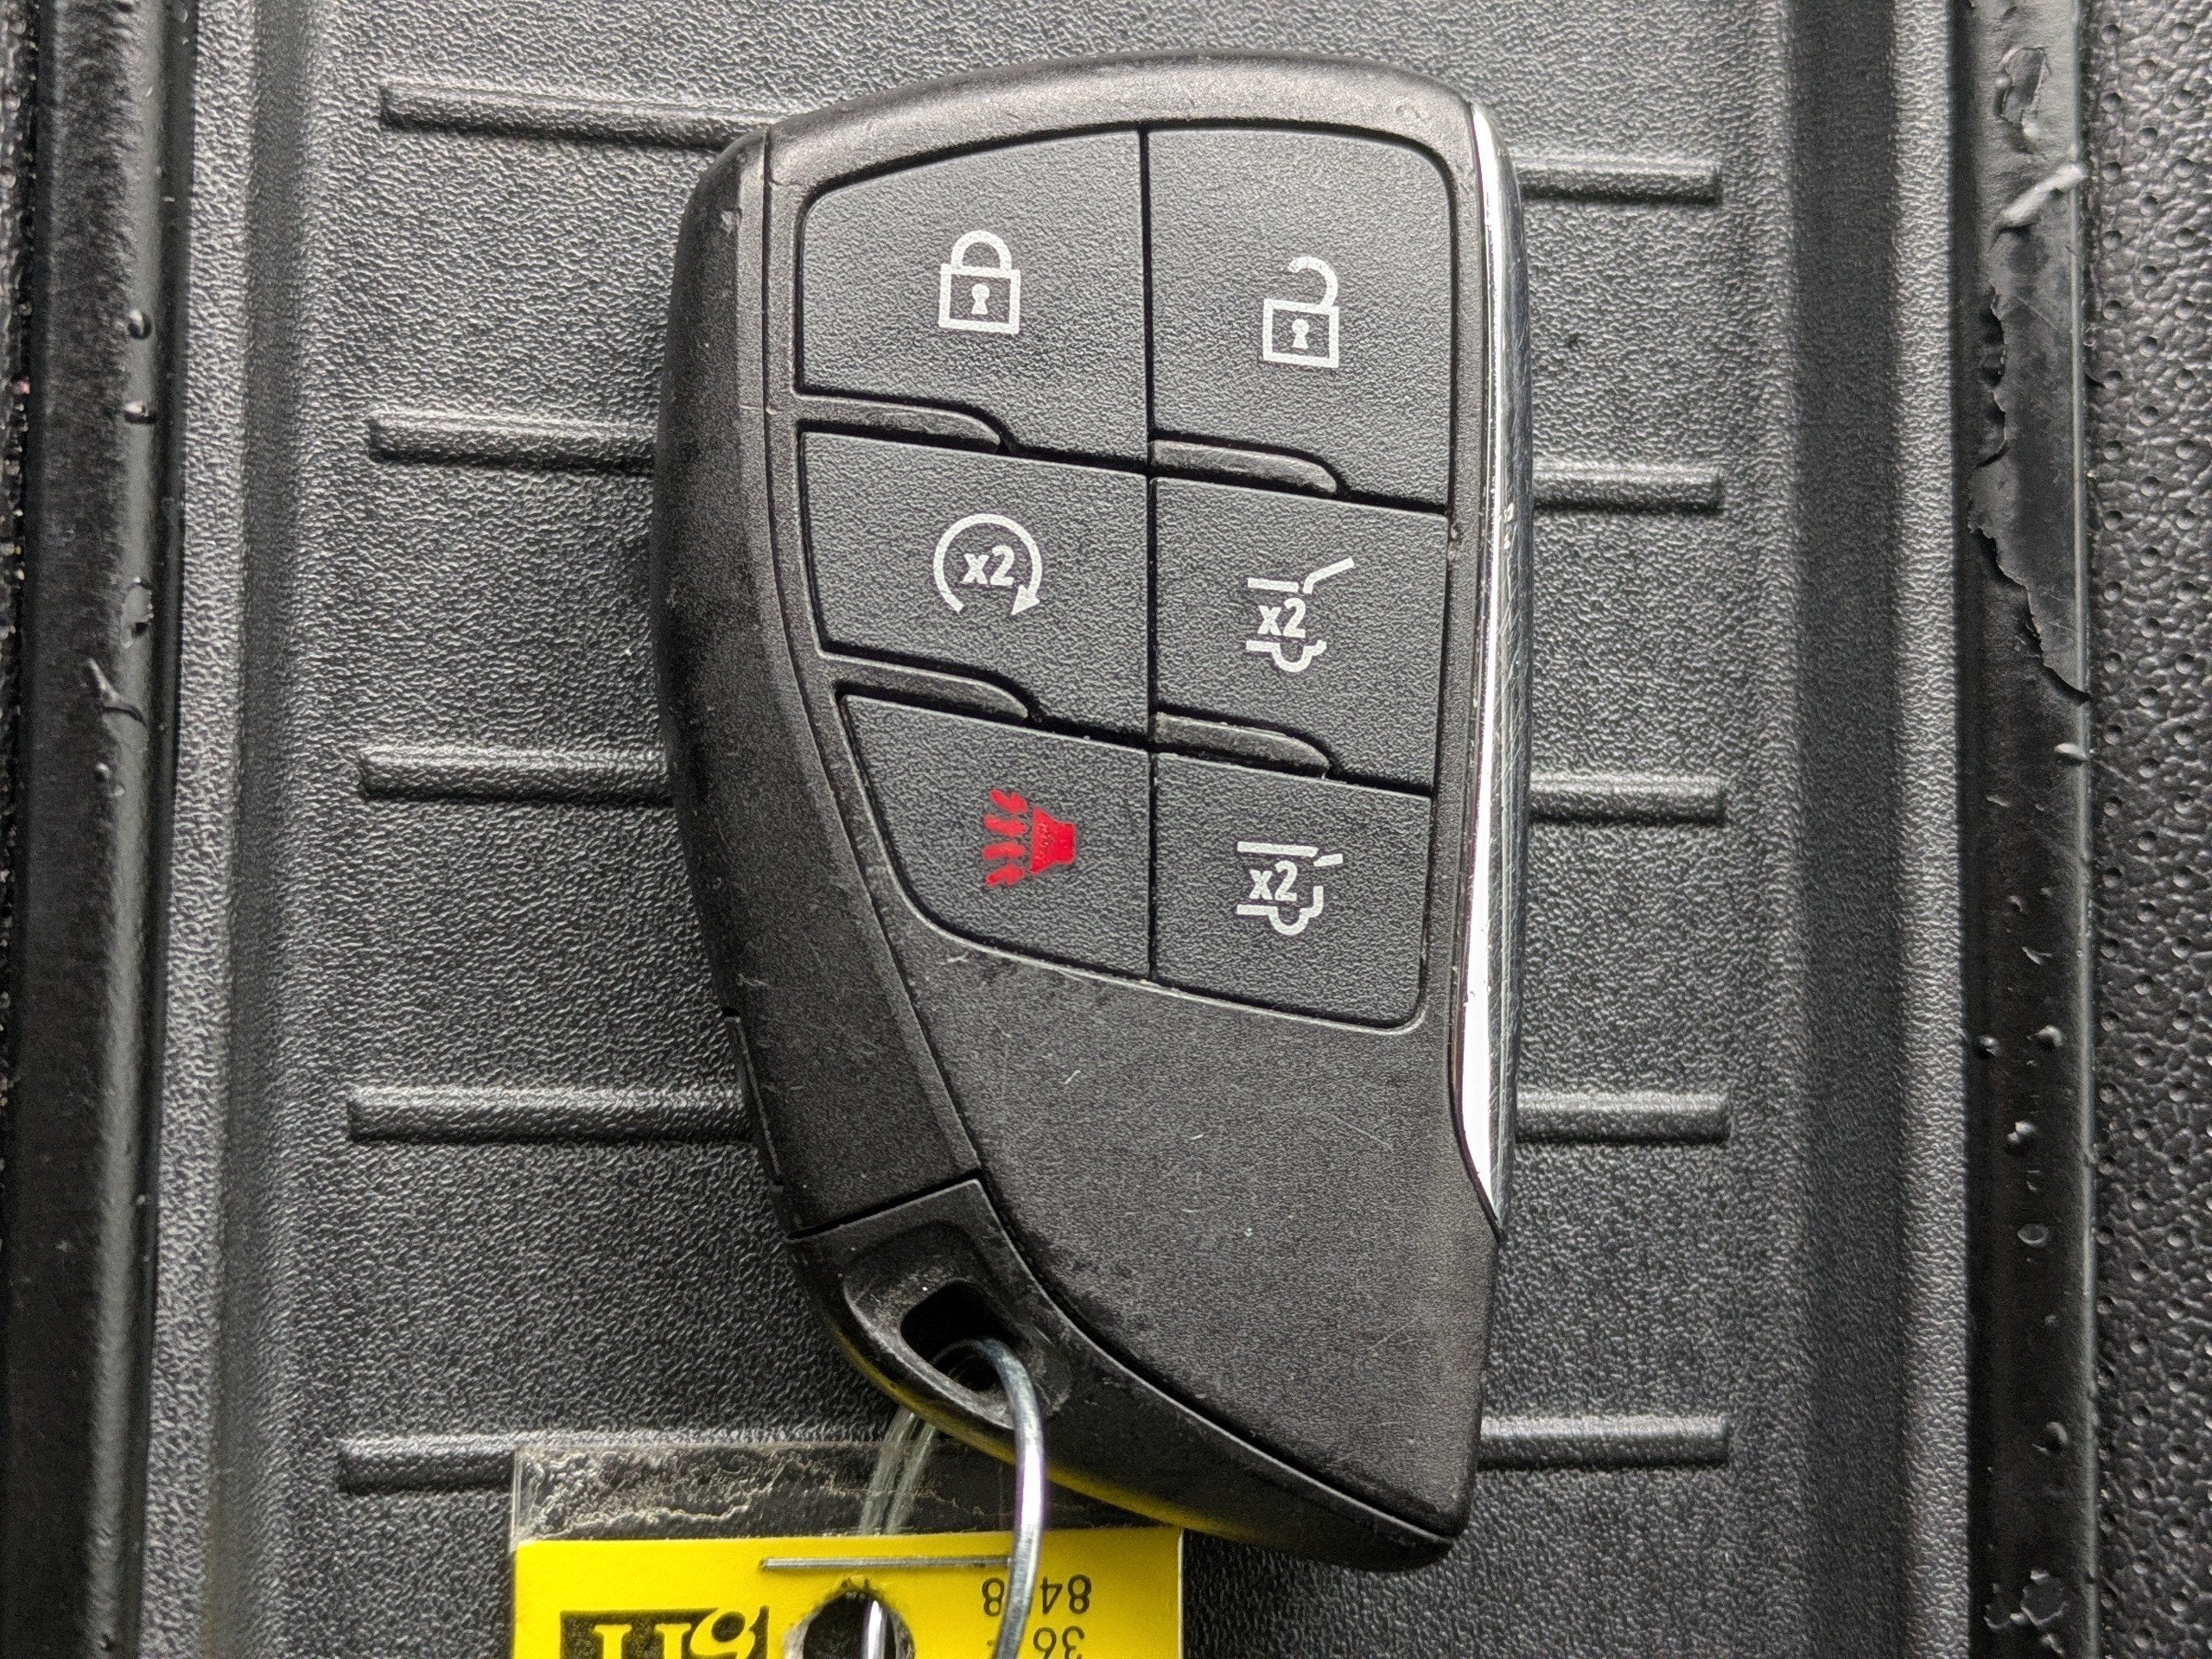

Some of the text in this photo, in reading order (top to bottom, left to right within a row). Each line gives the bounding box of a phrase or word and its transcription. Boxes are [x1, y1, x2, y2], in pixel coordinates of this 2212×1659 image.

[962, 544, 1015, 587] x2
[1257, 597, 1306, 639] x2
[1249, 861, 1298, 902] x2
